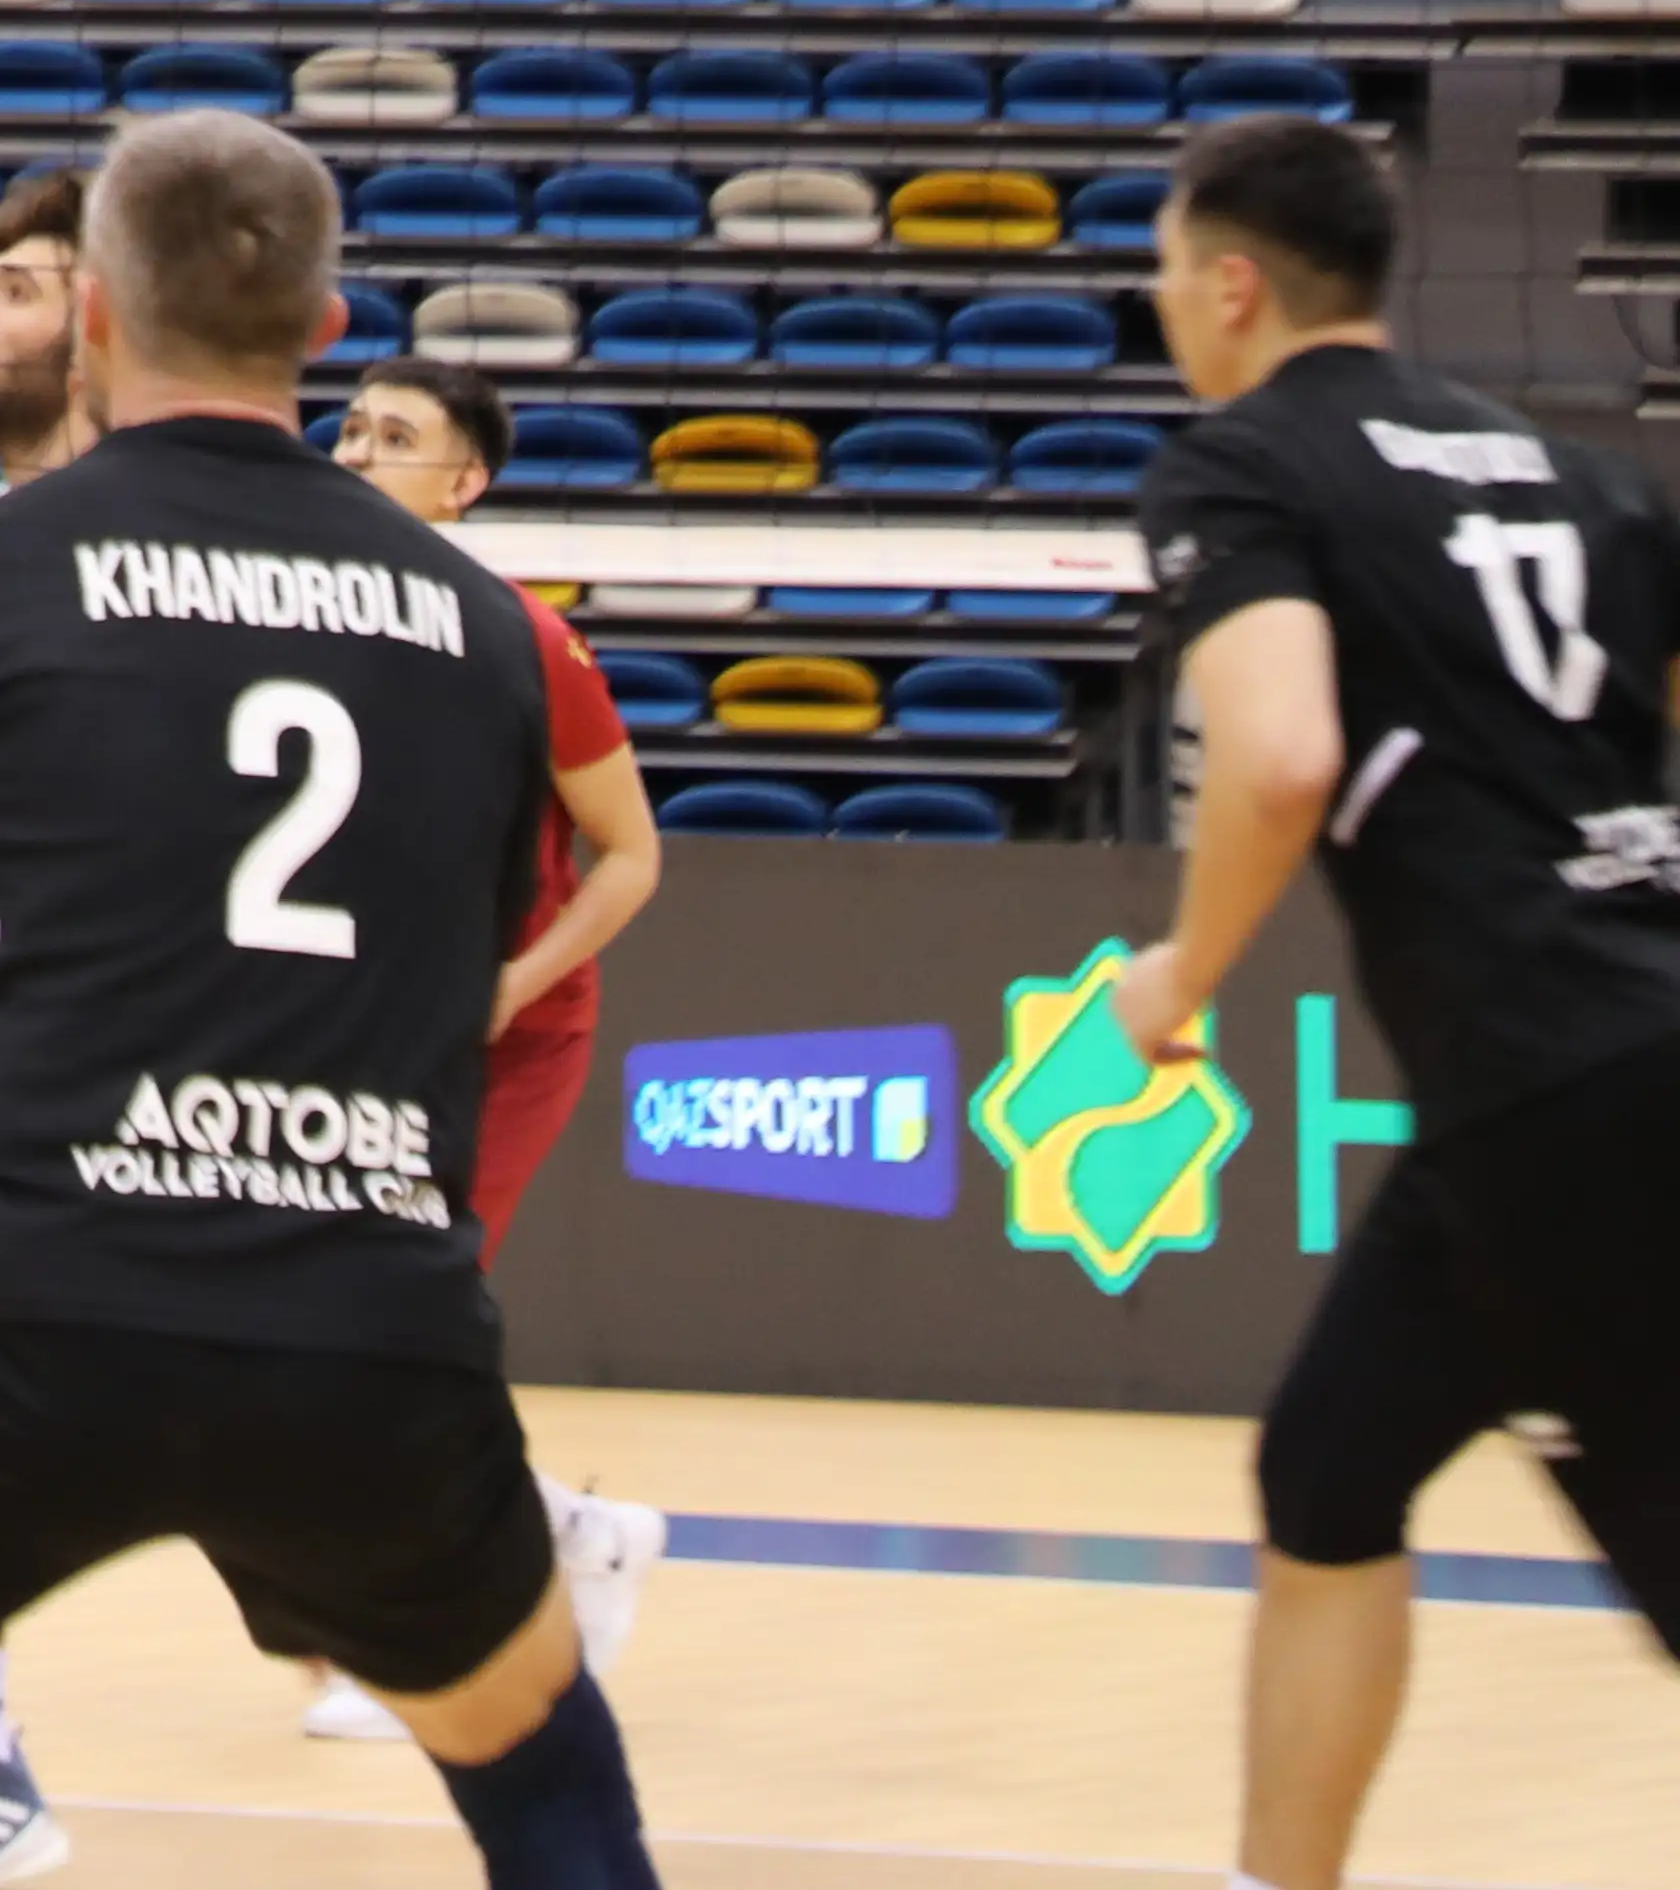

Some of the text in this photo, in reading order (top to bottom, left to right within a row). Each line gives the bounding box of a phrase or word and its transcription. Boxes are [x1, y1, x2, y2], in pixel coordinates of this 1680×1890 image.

[73, 539, 465, 658] KHANDROLIN
[225, 678, 362, 960] 2
[70, 1143, 364, 1212] VOLLEYBALL
[116, 1070, 434, 1178] AQTOBE
